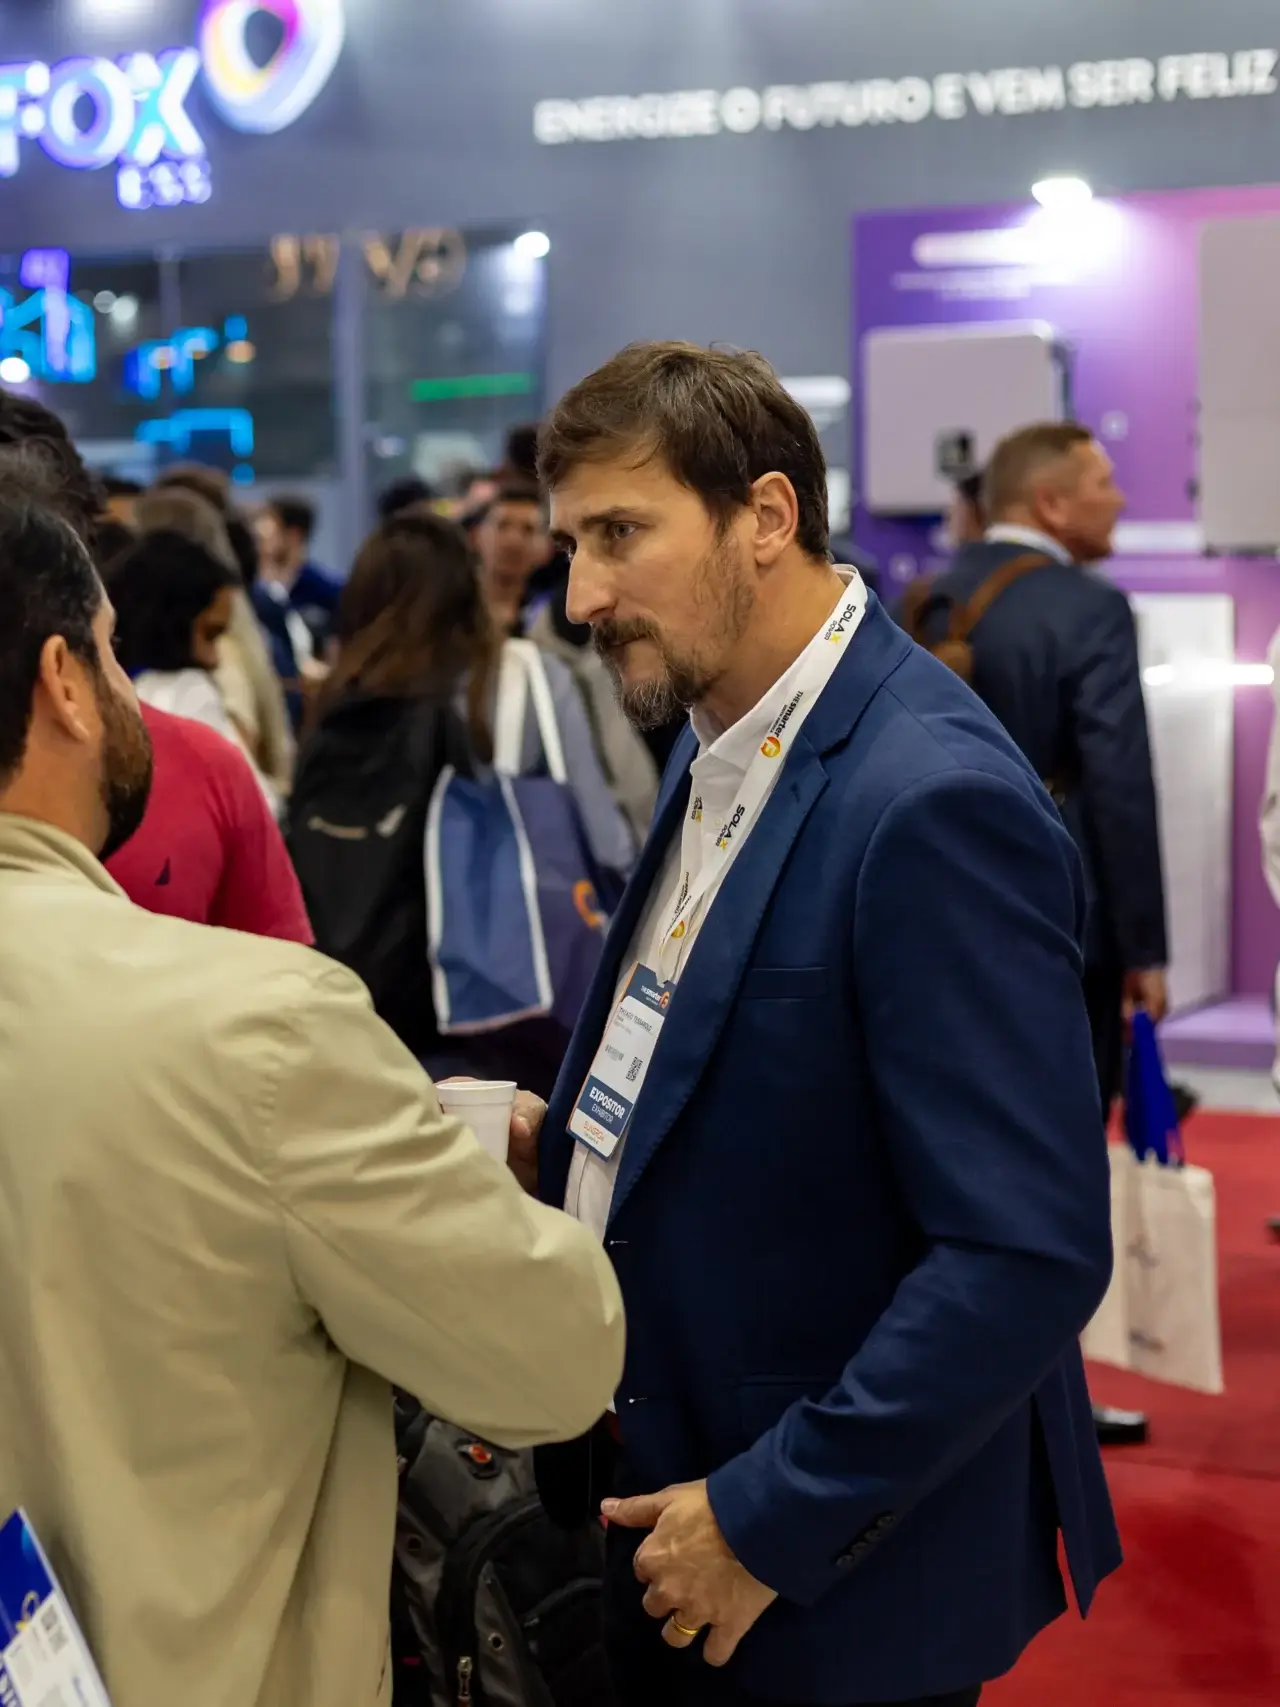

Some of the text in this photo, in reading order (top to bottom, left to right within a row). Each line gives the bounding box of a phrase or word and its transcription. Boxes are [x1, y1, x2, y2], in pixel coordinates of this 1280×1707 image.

[721, 86, 761, 134] O
[761, 76, 931, 132] FUTURO
[932, 72, 967, 120] E
[965, 64, 1067, 116] VEM
[1068, 57, 1156, 108] SER
[1157, 48, 1279, 102] FELIZ
[589, 1086, 626, 1119] EXPOSITOR
[591, 1103, 614, 1124] EXHIBITOR
